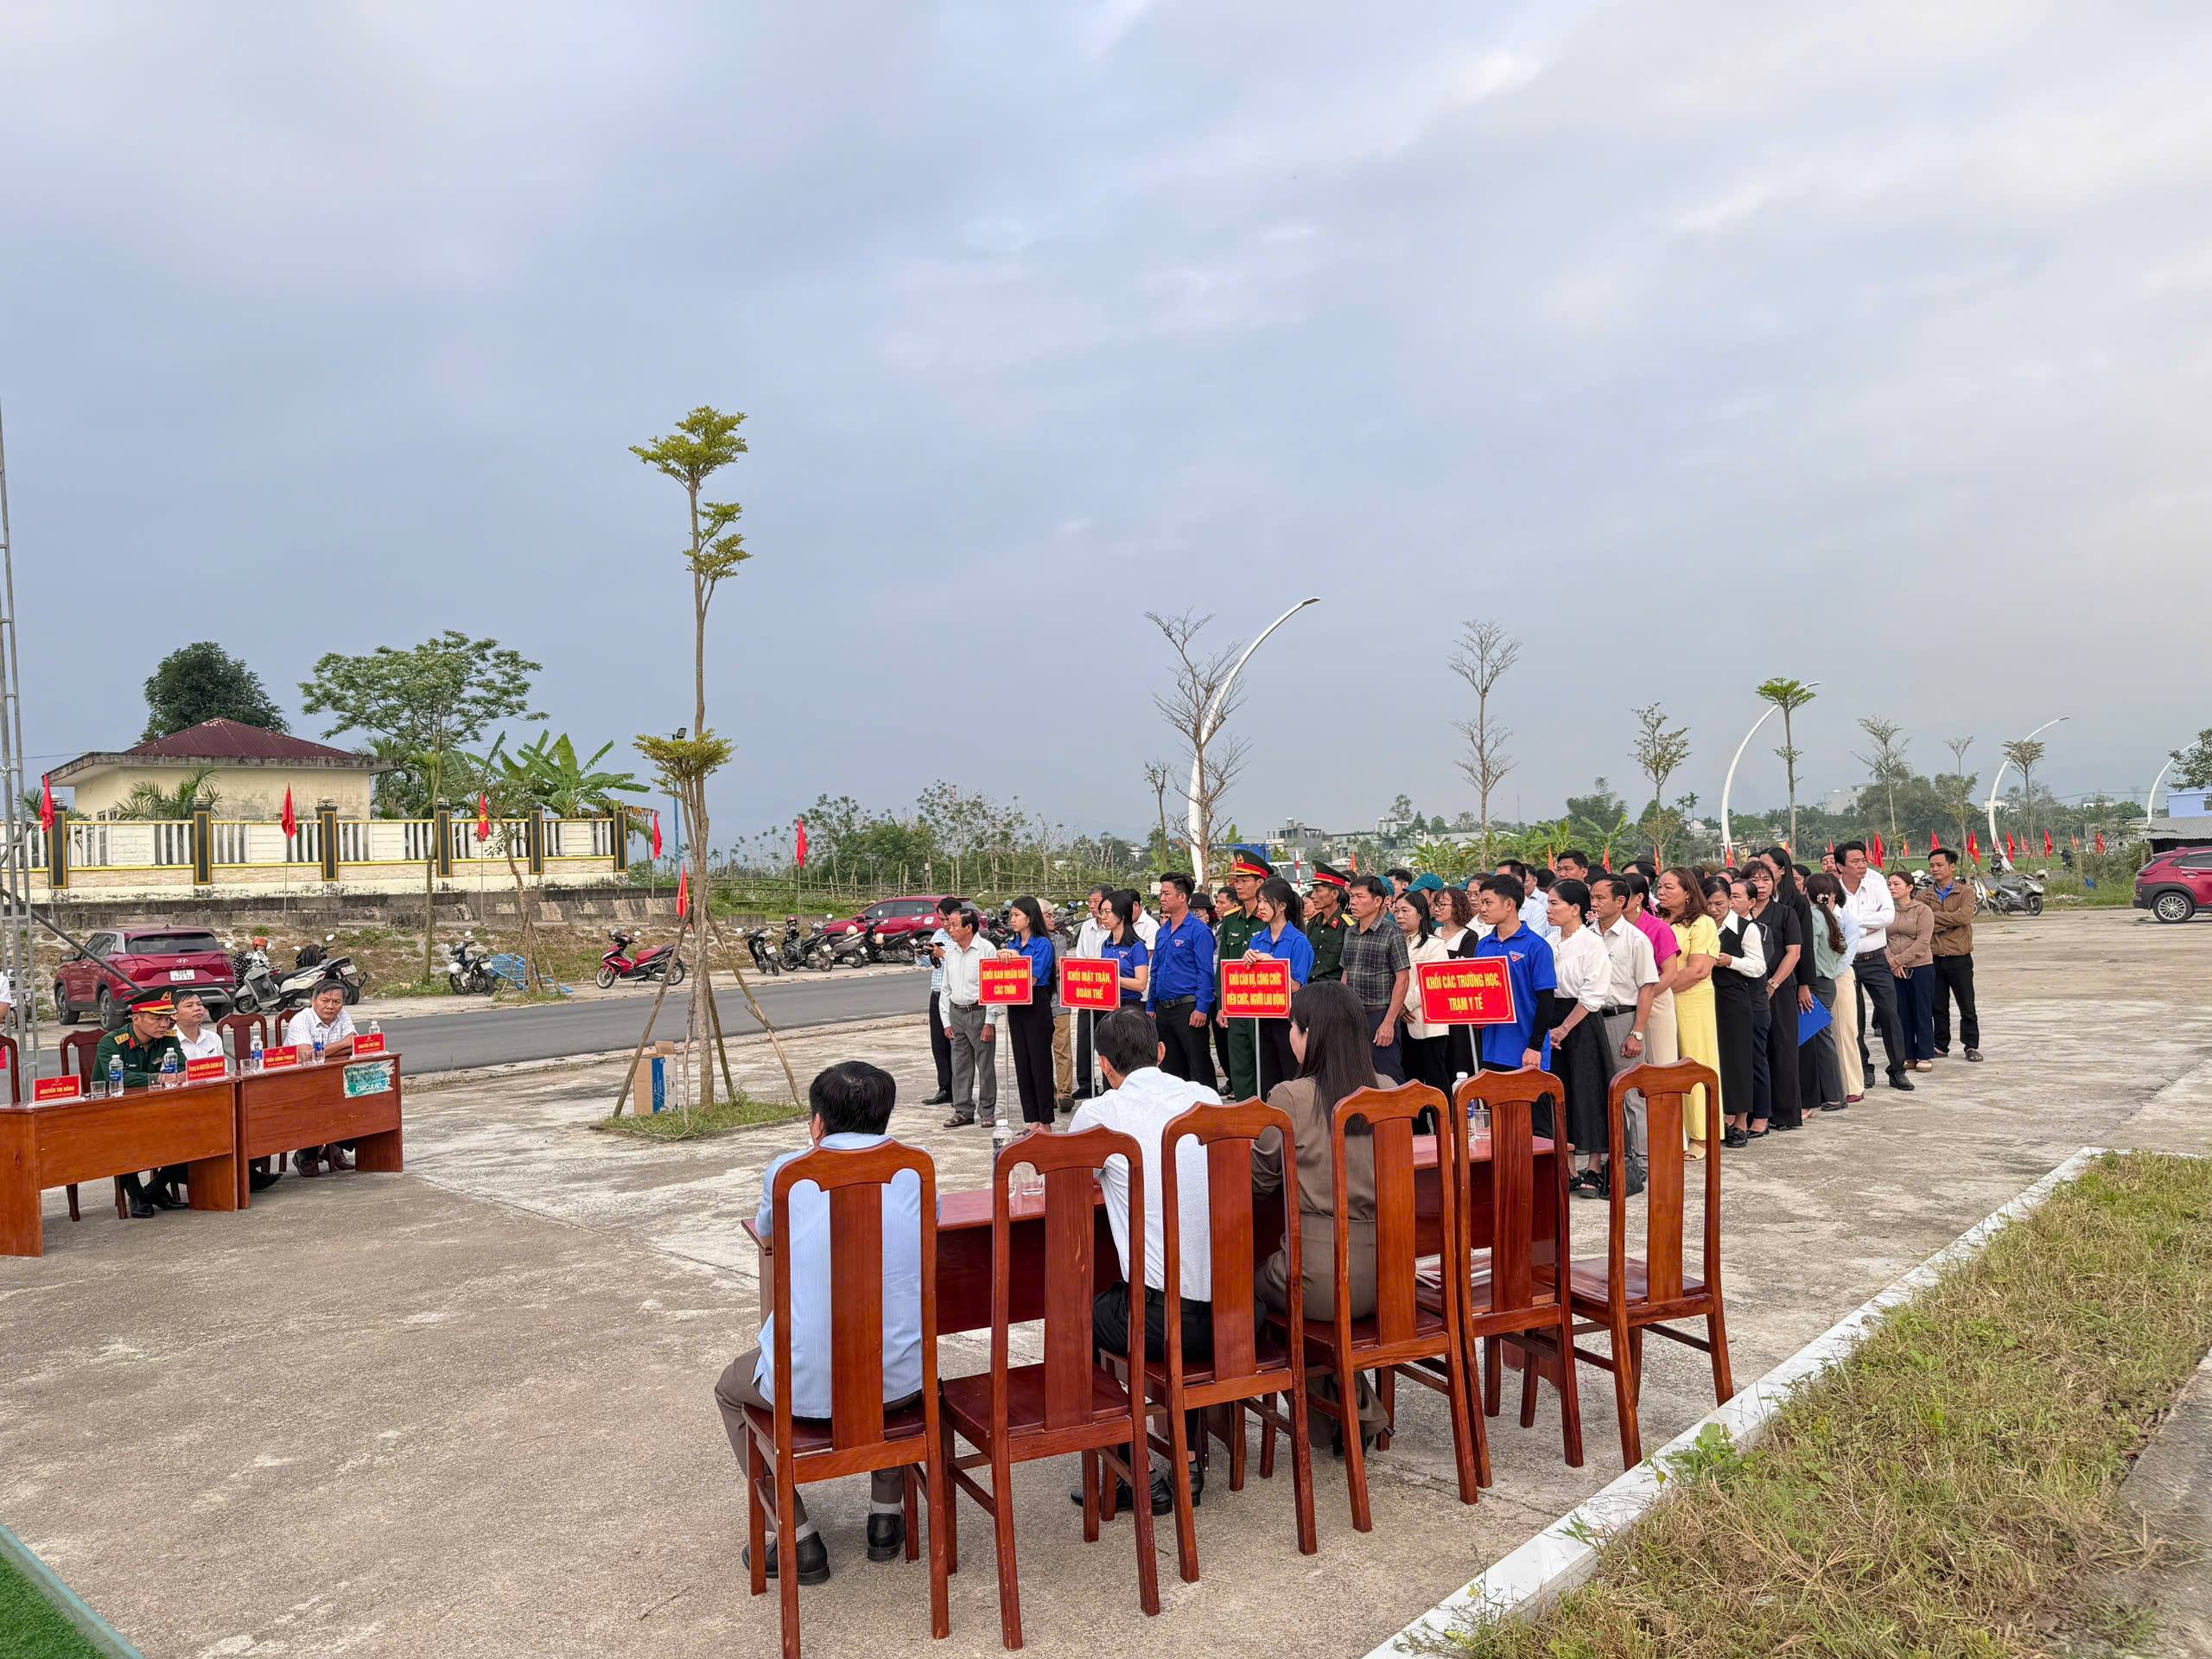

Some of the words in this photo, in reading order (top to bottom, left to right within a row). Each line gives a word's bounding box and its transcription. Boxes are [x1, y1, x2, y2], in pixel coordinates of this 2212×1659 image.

[1067, 968, 1080, 982] KHỐI
[1426, 971, 1442, 989] KHỐI
[1442, 972, 1456, 988] CÁC
[1457, 970, 1484, 988] TRƯỜNG
[1484, 972, 1502, 988] HỌC,
[1448, 997, 1468, 1014] TRẠM
[1468, 997, 1473, 1009] Y
[1474, 992, 1484, 1009] TẾ
